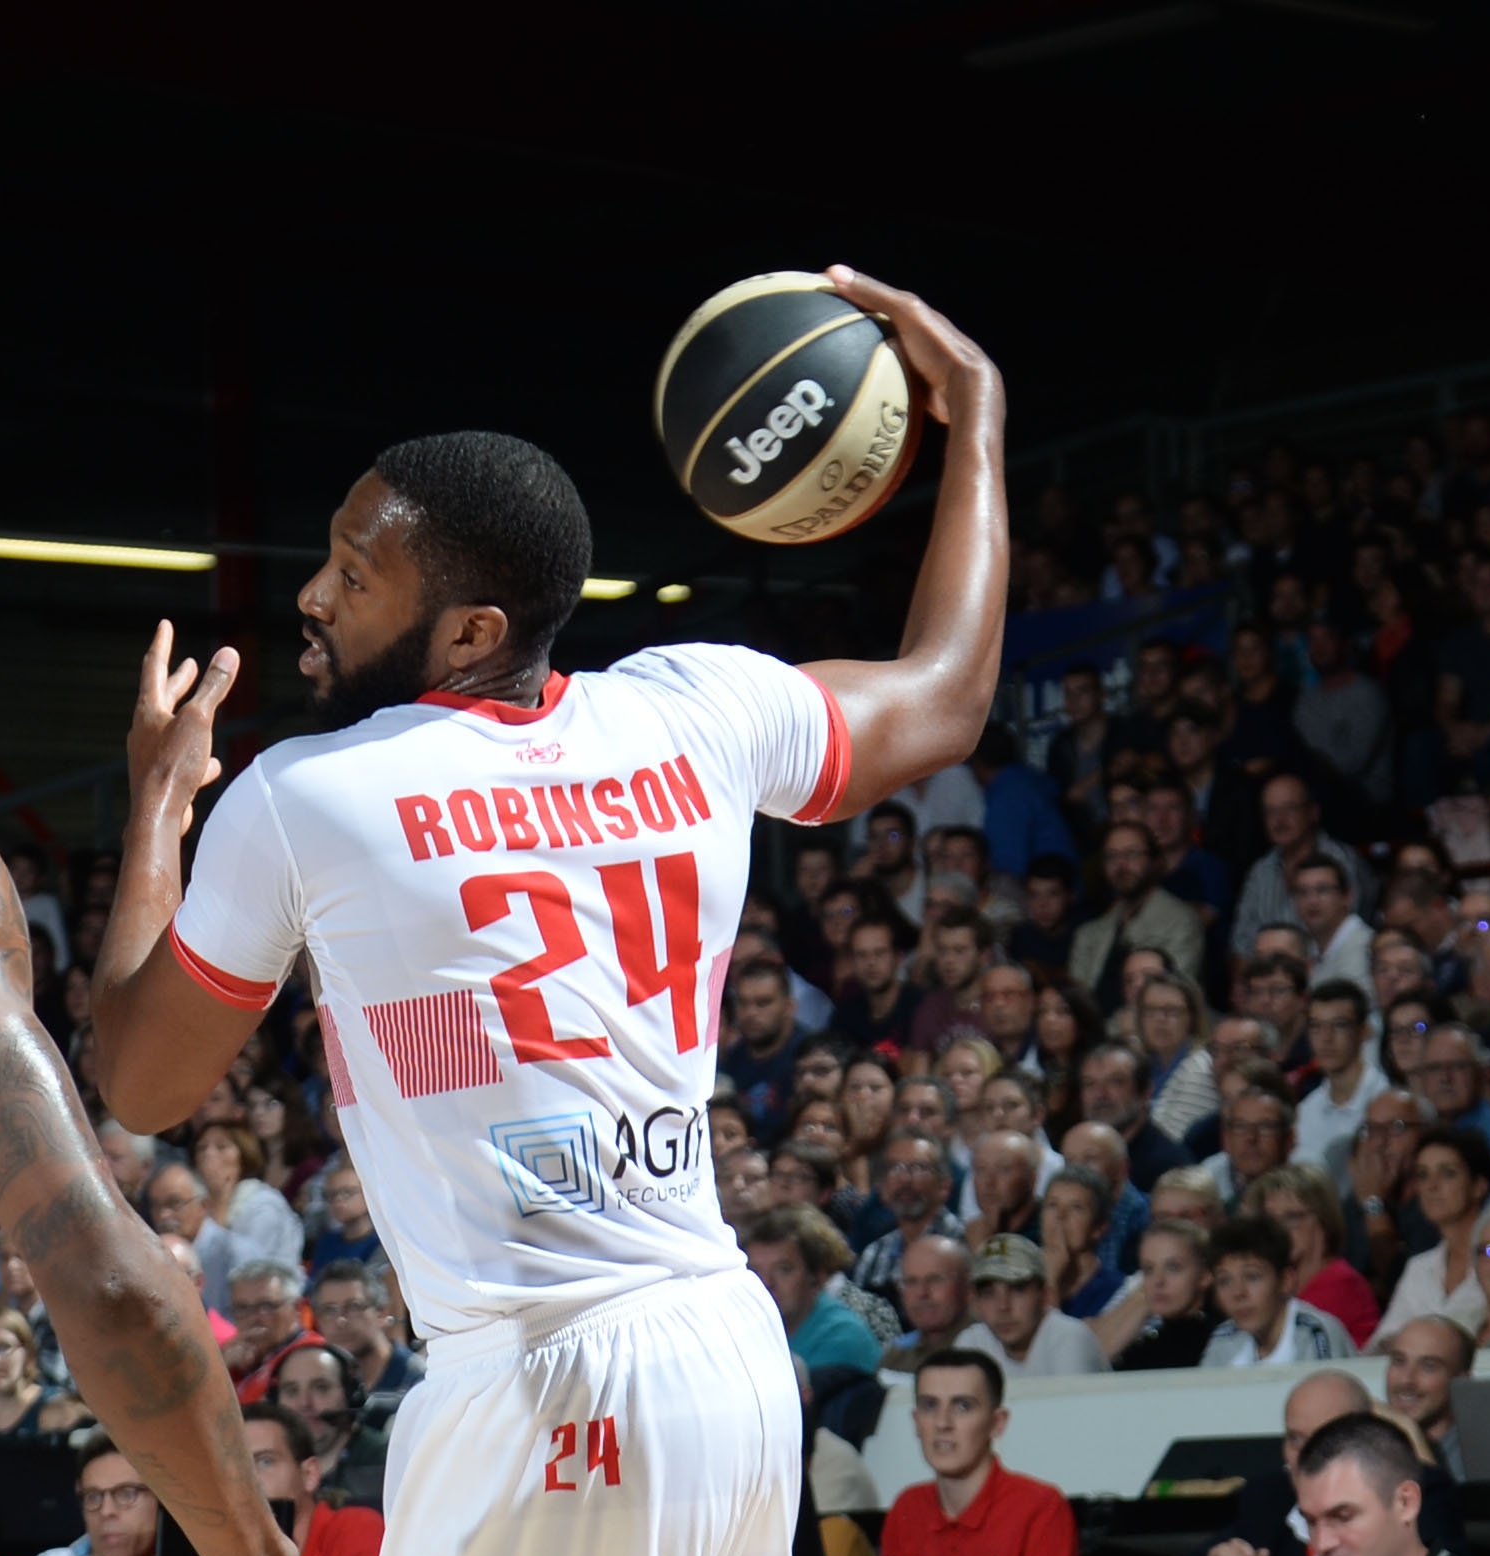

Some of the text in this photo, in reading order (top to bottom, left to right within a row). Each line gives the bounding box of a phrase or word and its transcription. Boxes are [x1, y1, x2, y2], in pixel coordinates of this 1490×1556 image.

[724, 379, 829, 485] Jeep
[771, 401, 908, 541] SPALDING
[395, 754, 711, 861] ROBINSON
[459, 851, 702, 1064] 24
[544, 1416, 620, 1492] 24
